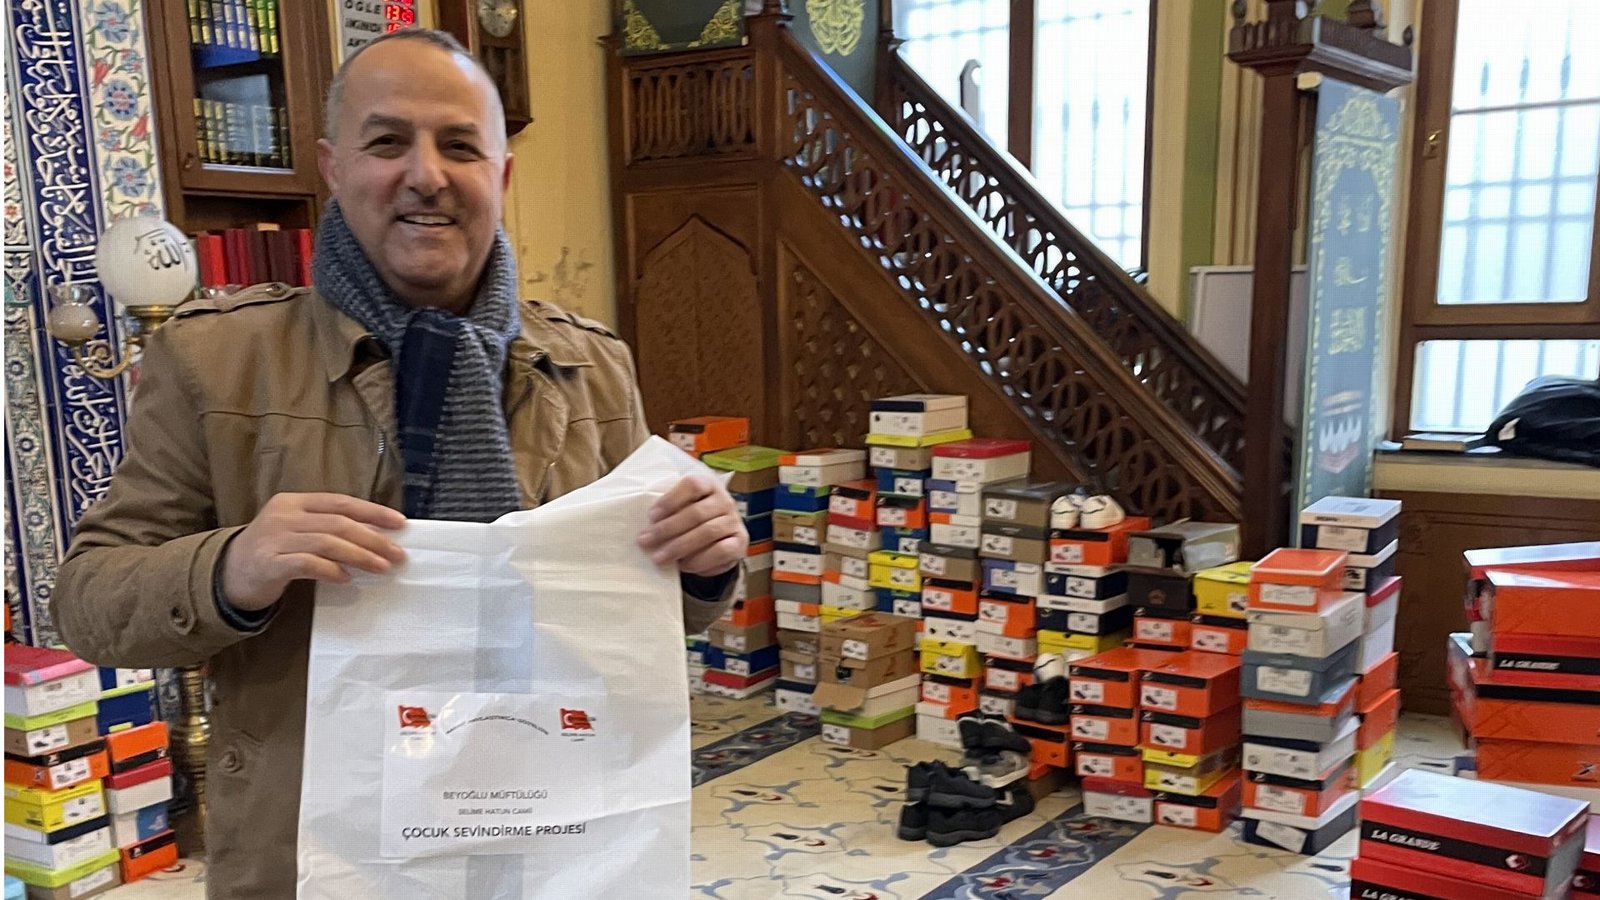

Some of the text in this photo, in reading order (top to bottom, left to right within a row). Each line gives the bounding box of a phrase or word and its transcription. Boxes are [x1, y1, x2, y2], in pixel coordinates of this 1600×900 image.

[443, 789, 548, 800] BEYOĞLU MÜFTÜLÜĞÜ
[402, 822, 586, 841] ÇOCUK SEVİNDİRME PROJESİ
[1370, 829, 1388, 840] LA
[1361, 888, 1379, 900] LA
